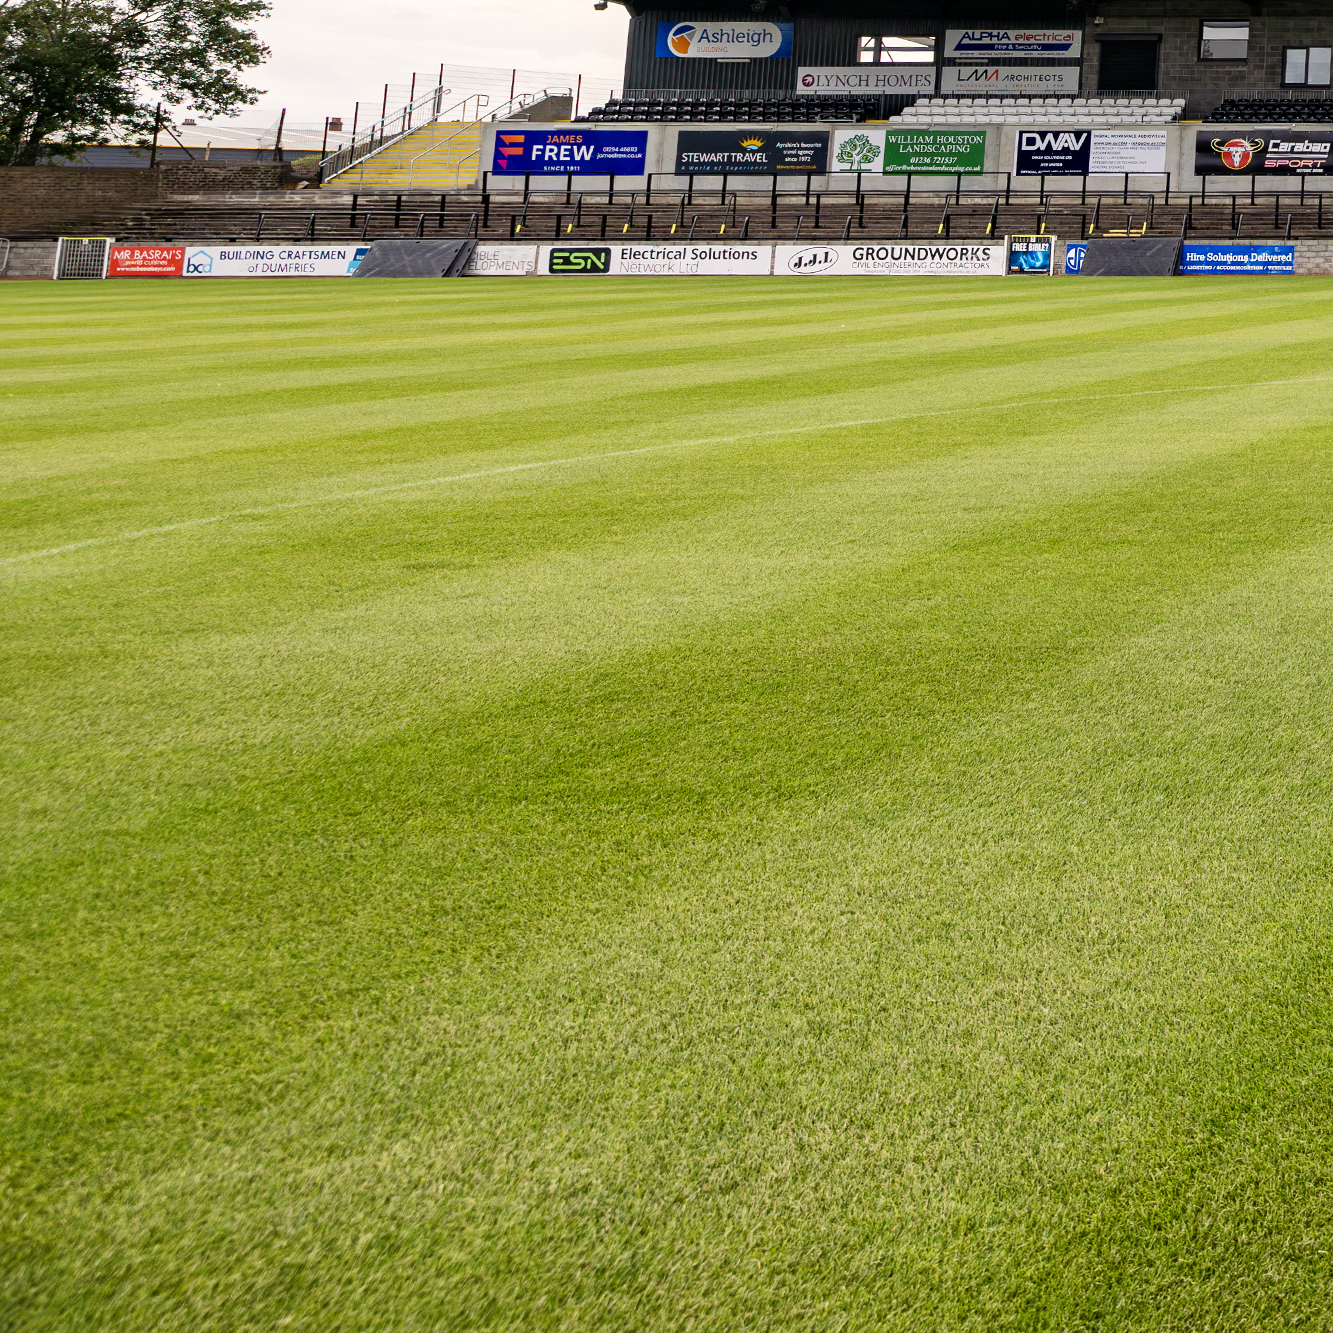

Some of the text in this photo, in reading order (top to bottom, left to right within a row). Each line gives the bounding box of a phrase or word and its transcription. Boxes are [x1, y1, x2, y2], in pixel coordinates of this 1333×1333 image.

[698, 28, 774, 47] Ashleigh
[961, 31, 1075, 42] ALPHA electrical
[815, 74, 932, 87] LYNCH HOMES
[957, 68, 1064, 83] LMA ARCHITECTS
[546, 135, 583, 143] JAMES
[888, 135, 984, 144] WILLIAM HOUSTON
[1021, 132, 1088, 151] DWAV
[899, 144, 971, 153] LANDSCAPING
[1268, 139, 1331, 154] Carabao
[531, 145, 595, 161] FREW
[681, 152, 768, 163] STEWART TRAVEL
[910, 156, 958, 164] 01236 721537
[1263, 160, 1327, 168] SPORT
[1011, 243, 1050, 252] FREE BIBLE?
[113, 249, 182, 260] MR BASRAI'S
[219, 250, 347, 260] BUILDING CRAFTSMEN
[620, 247, 758, 261] Electrical Solutions
[851, 247, 991, 261] GROUNDWORKS
[1186, 252, 1293, 263] Hire Solutions Delivered
[248, 263, 316, 273] of DUMFRIES
[619, 261, 699, 274] Network Ltd
[851, 261, 990, 269] CIVIL ENGINEERING CONTRACTORS
